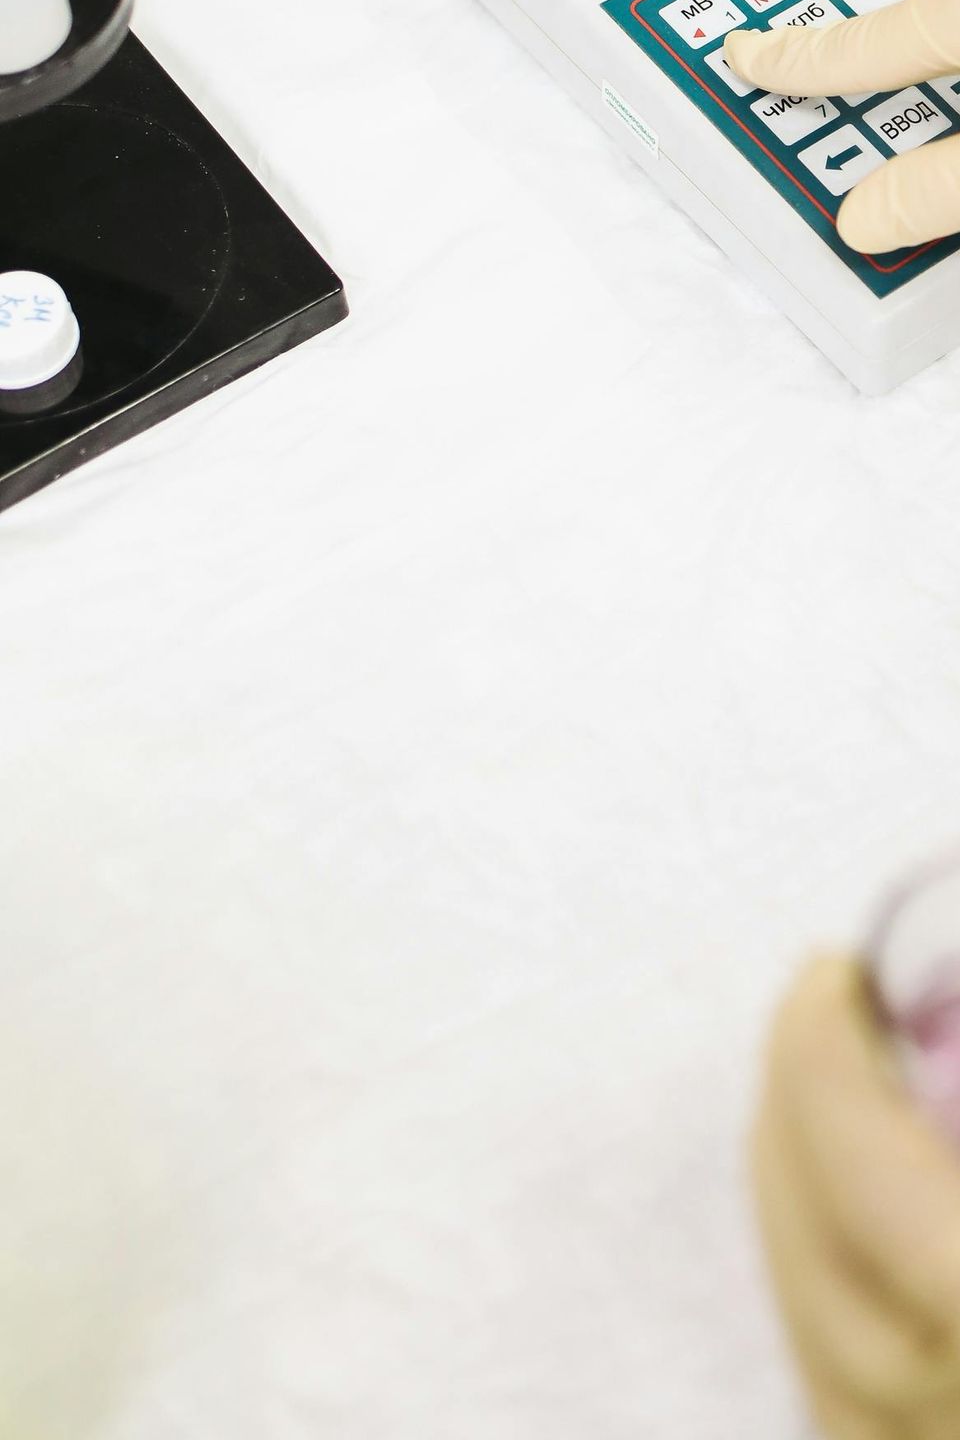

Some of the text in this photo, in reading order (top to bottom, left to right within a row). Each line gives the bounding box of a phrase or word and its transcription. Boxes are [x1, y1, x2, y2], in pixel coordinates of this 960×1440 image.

[725, 11, 737, 21] 1
[762, 95, 809, 117] чис
[814, 104, 827, 118] 7
[879, 101, 939, 140] ВВОД
